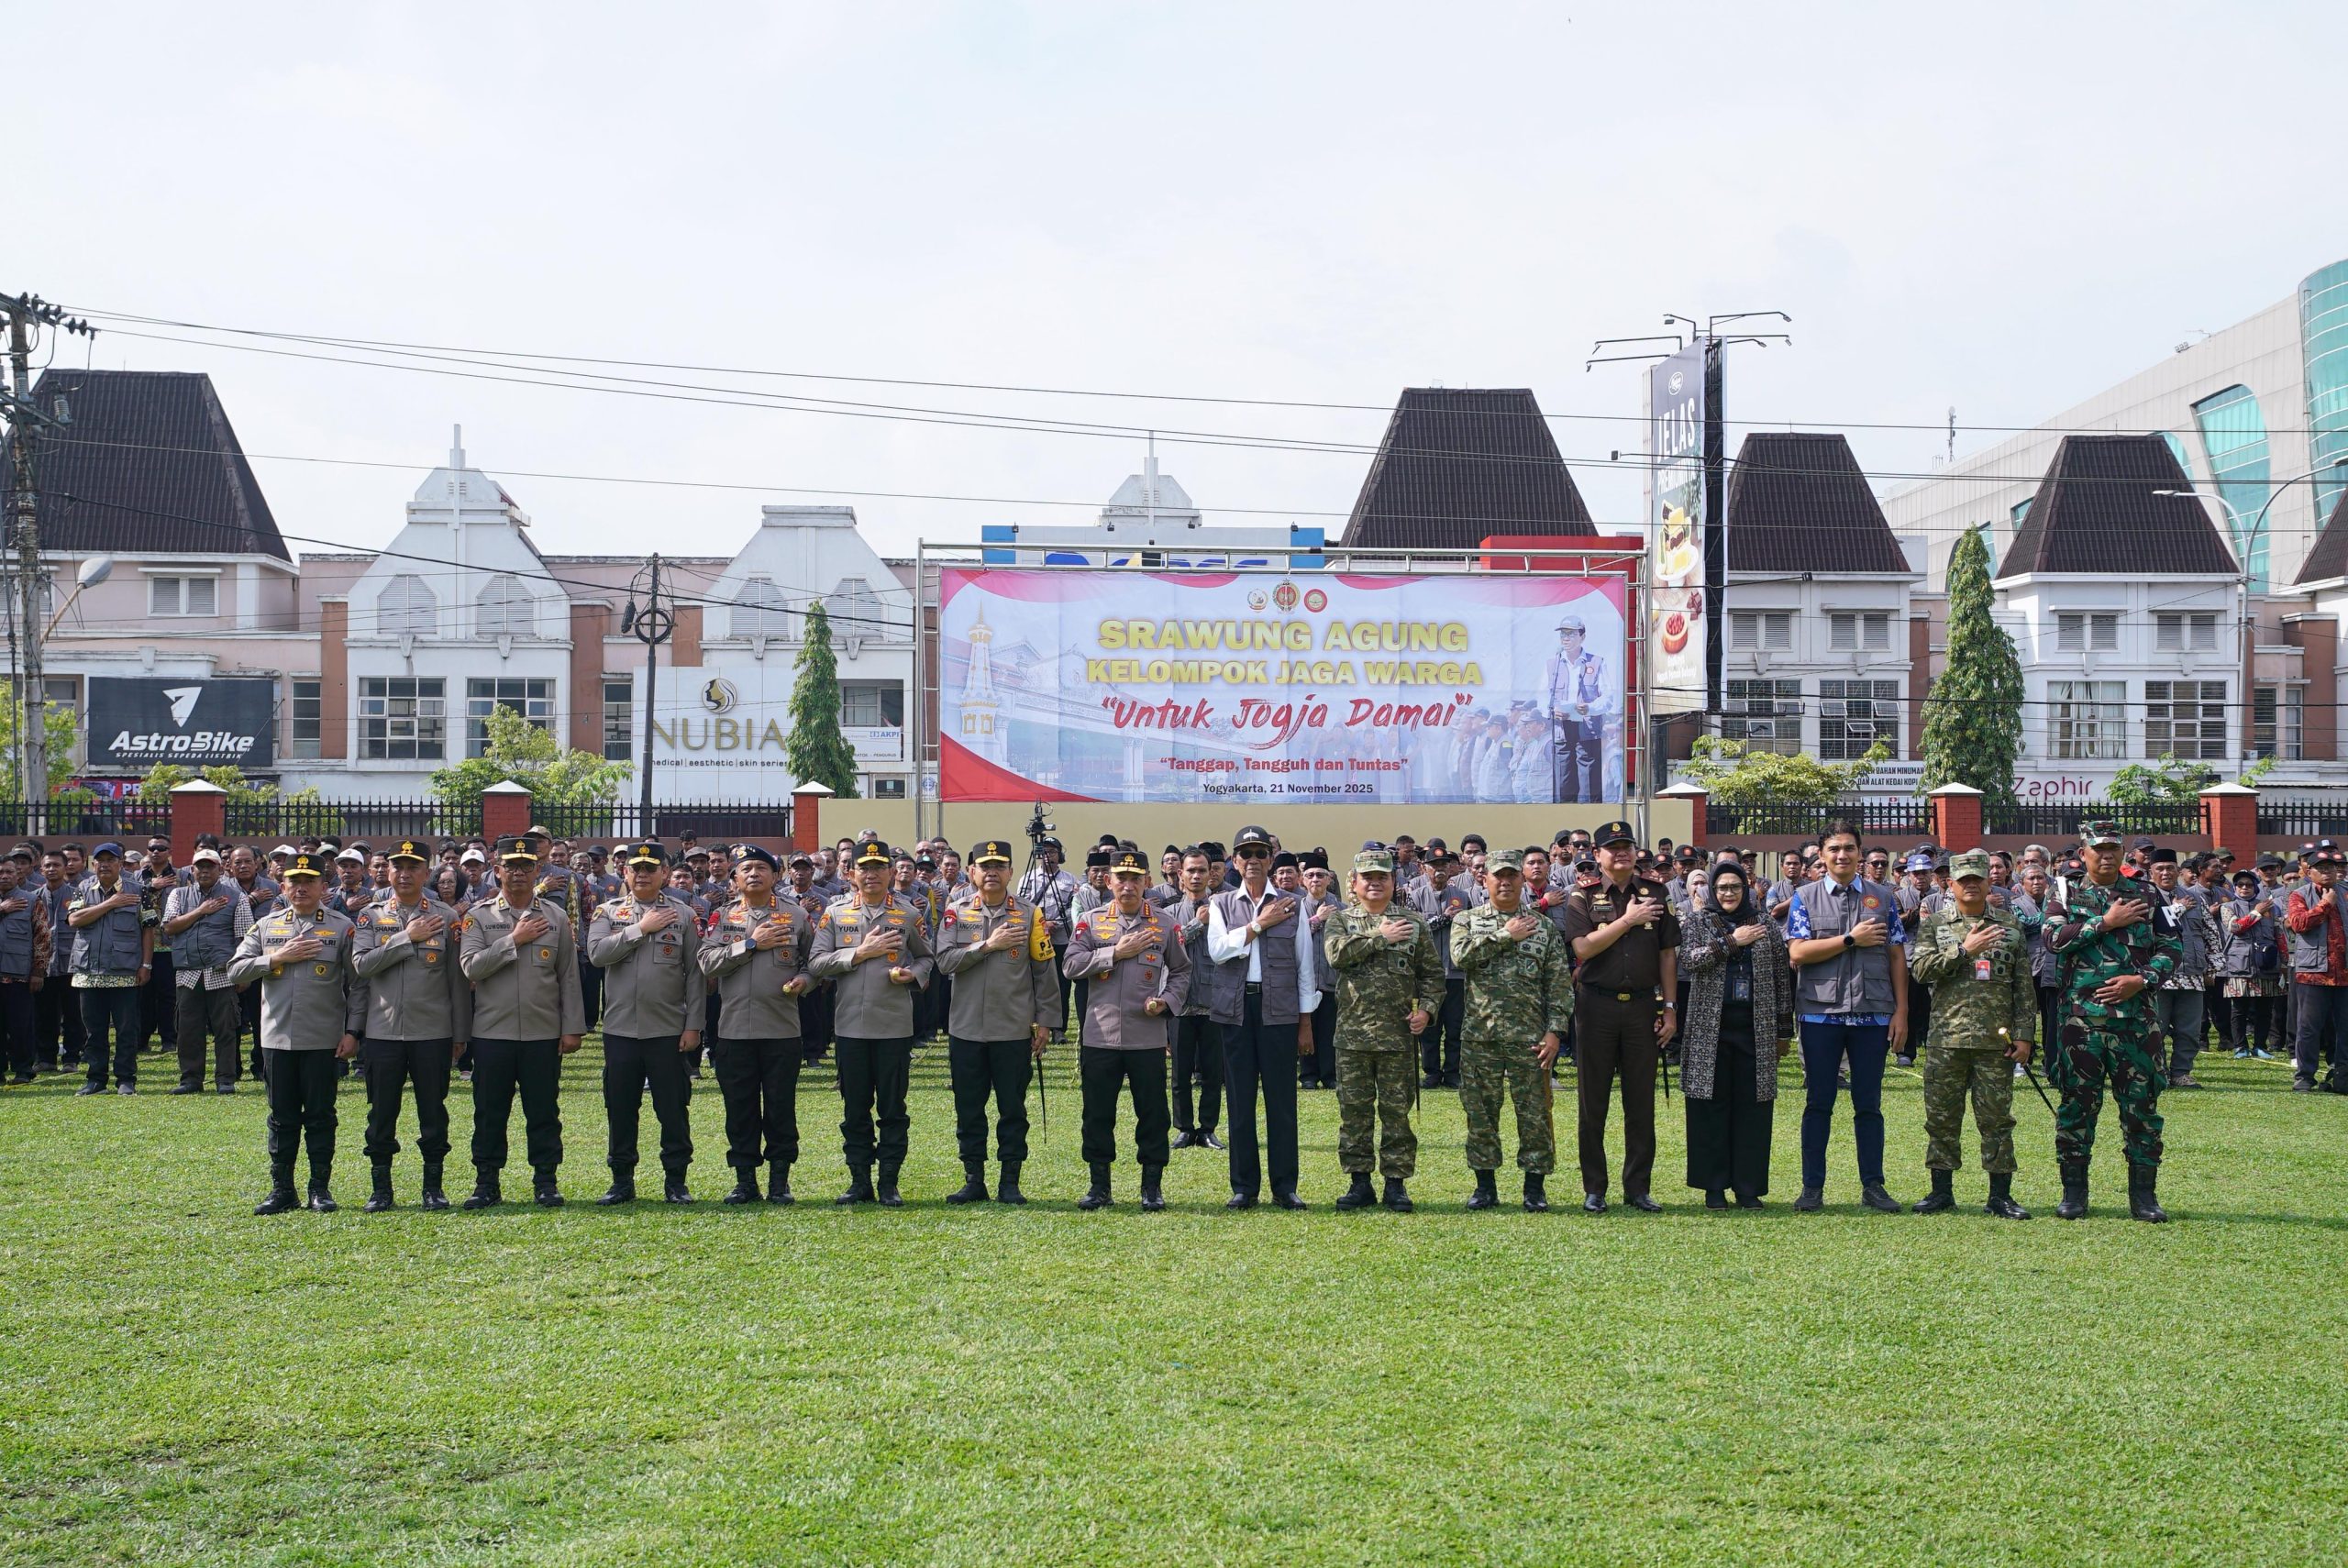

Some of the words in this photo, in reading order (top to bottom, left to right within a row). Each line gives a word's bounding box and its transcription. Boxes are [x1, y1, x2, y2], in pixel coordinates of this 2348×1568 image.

[1656, 398, 1695, 464] JELAS
[1099, 620, 1312, 650] SRAWUNG
[1324, 622, 1468, 652] AGUNG
[1087, 659, 1269, 684] KELOMPOK
[1276, 661, 1357, 685] JAGA
[1363, 661, 1483, 685] WARGA
[652, 718, 786, 750] NUBIA
[1232, 694, 1328, 751] Jogja
[108, 730, 255, 753] AstroBike
[689, 757, 734, 767] aesthetic
[739, 757, 758, 767] skin
[1160, 757, 1239, 773] “Tanggap,
[1243, 757, 1310, 773] Tangguh
[1314, 757, 1344, 771] dan
[1348, 757, 1408, 771] Tuntas”
[1876, 767, 1896, 775] BAHAN
[1202, 784, 1267, 796] Yogyakarta,
[1270, 784, 1284, 793] 21
[1288, 784, 1342, 793] November
[1345, 784, 1373, 793] 2025
[1871, 778, 1884, 786] ALAT
[1886, 778, 1902, 786] KEDAI
[1904, 778, 1918, 786] KOPI
[2012, 776, 2093, 801] Zaphir
